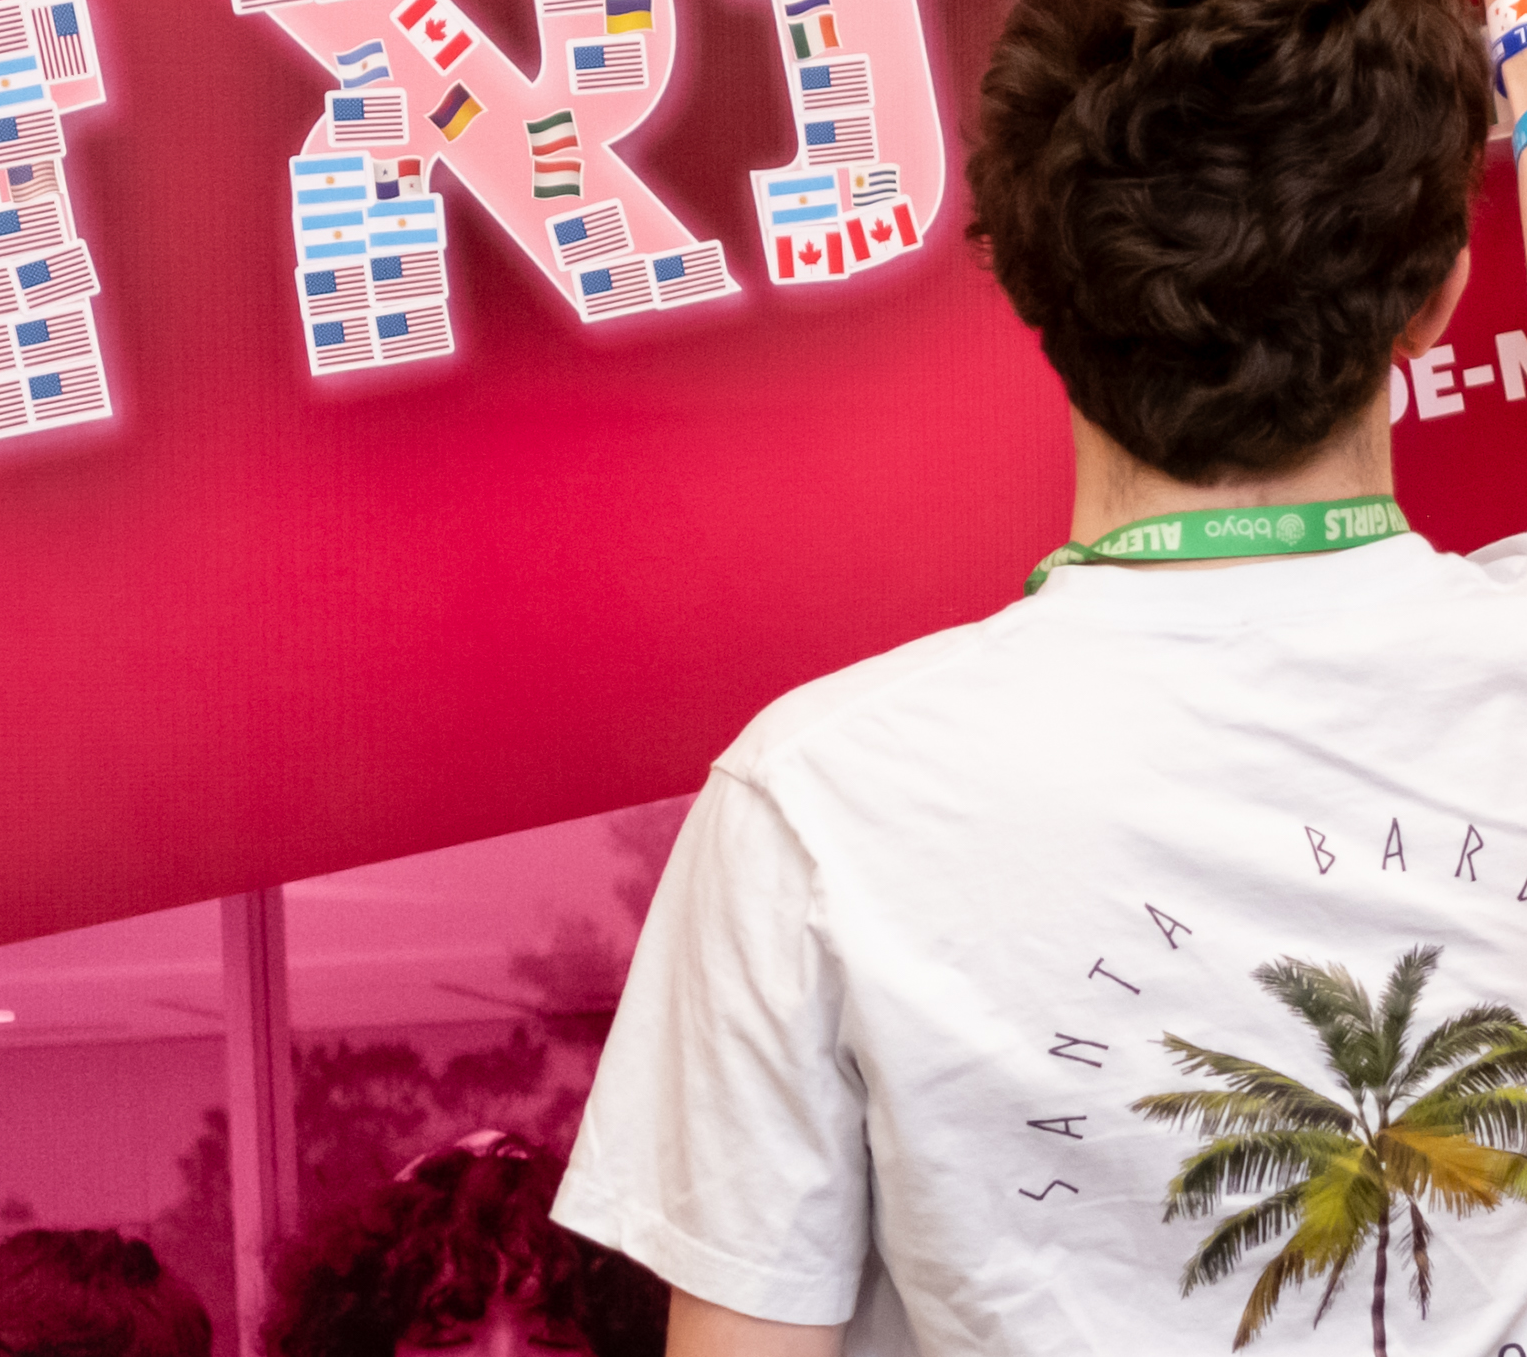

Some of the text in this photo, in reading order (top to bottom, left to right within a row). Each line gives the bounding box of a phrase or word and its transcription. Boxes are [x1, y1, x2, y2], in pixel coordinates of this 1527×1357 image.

[1204, 516, 1271, 539] bbyo
[1324, 502, 1388, 541] GIRLS
[1017, 901, 1193, 1203] SANTA
